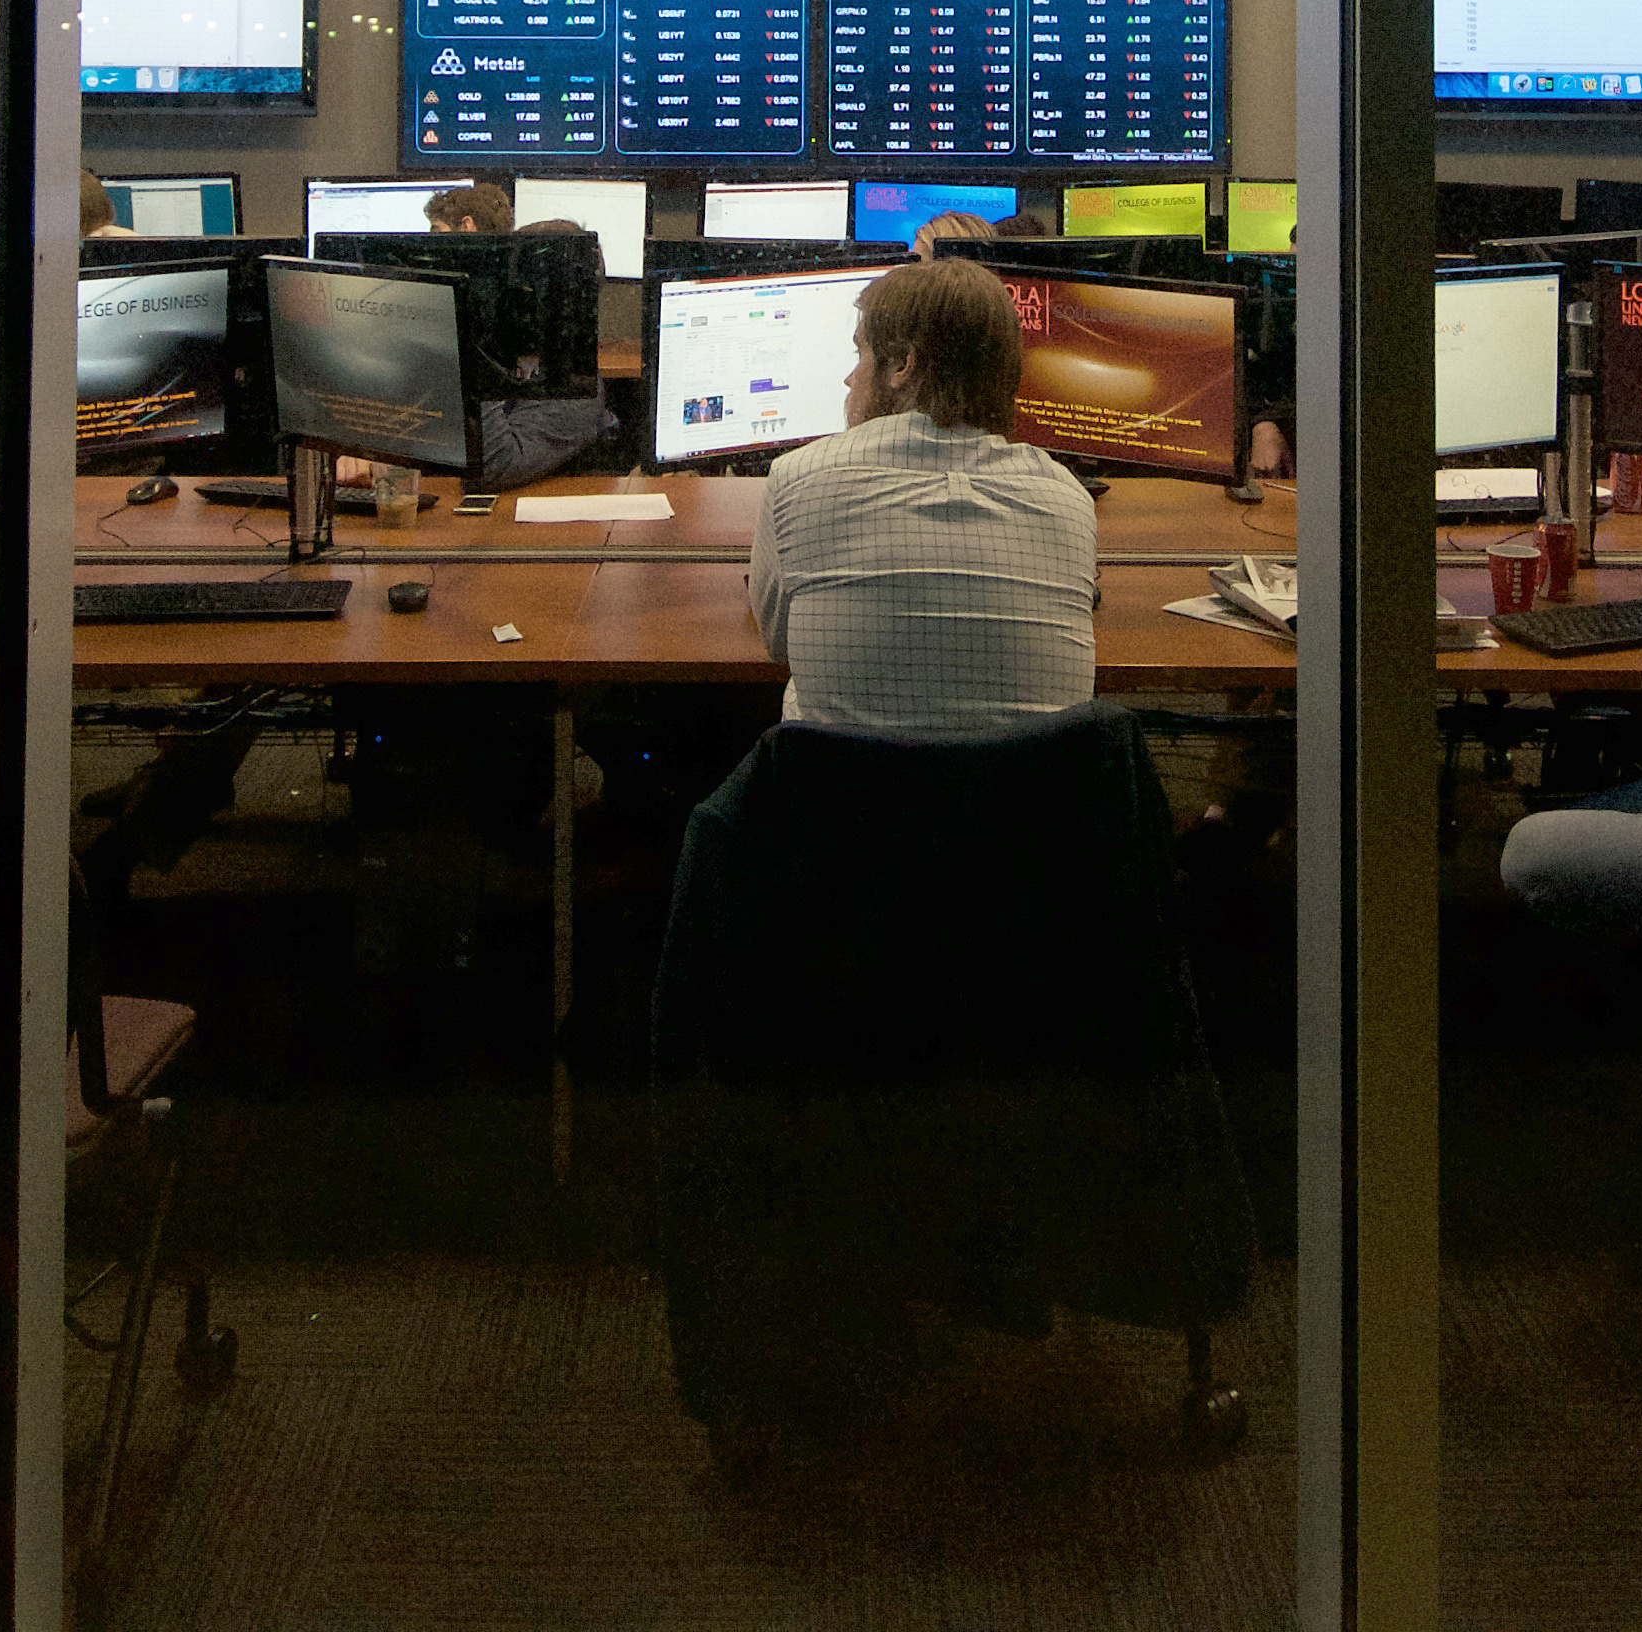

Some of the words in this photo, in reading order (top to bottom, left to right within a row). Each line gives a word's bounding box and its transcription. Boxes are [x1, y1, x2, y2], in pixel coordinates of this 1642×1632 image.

[474, 57, 525, 71] Metals
[458, 93, 482, 101] GOLD
[915, 197, 953, 207] COLLEGE
[955, 198, 964, 207] OF
[967, 199, 1005, 208] BUSINESS
[1117, 199, 1150, 208] COLLEGE
[1151, 198, 1160, 207] OF
[1163, 196, 1197, 206] BUSINESS
[117, 300, 138, 315] OF
[142, 294, 209, 313] BUSINESS
[335, 297, 379, 316] COLLEGE
